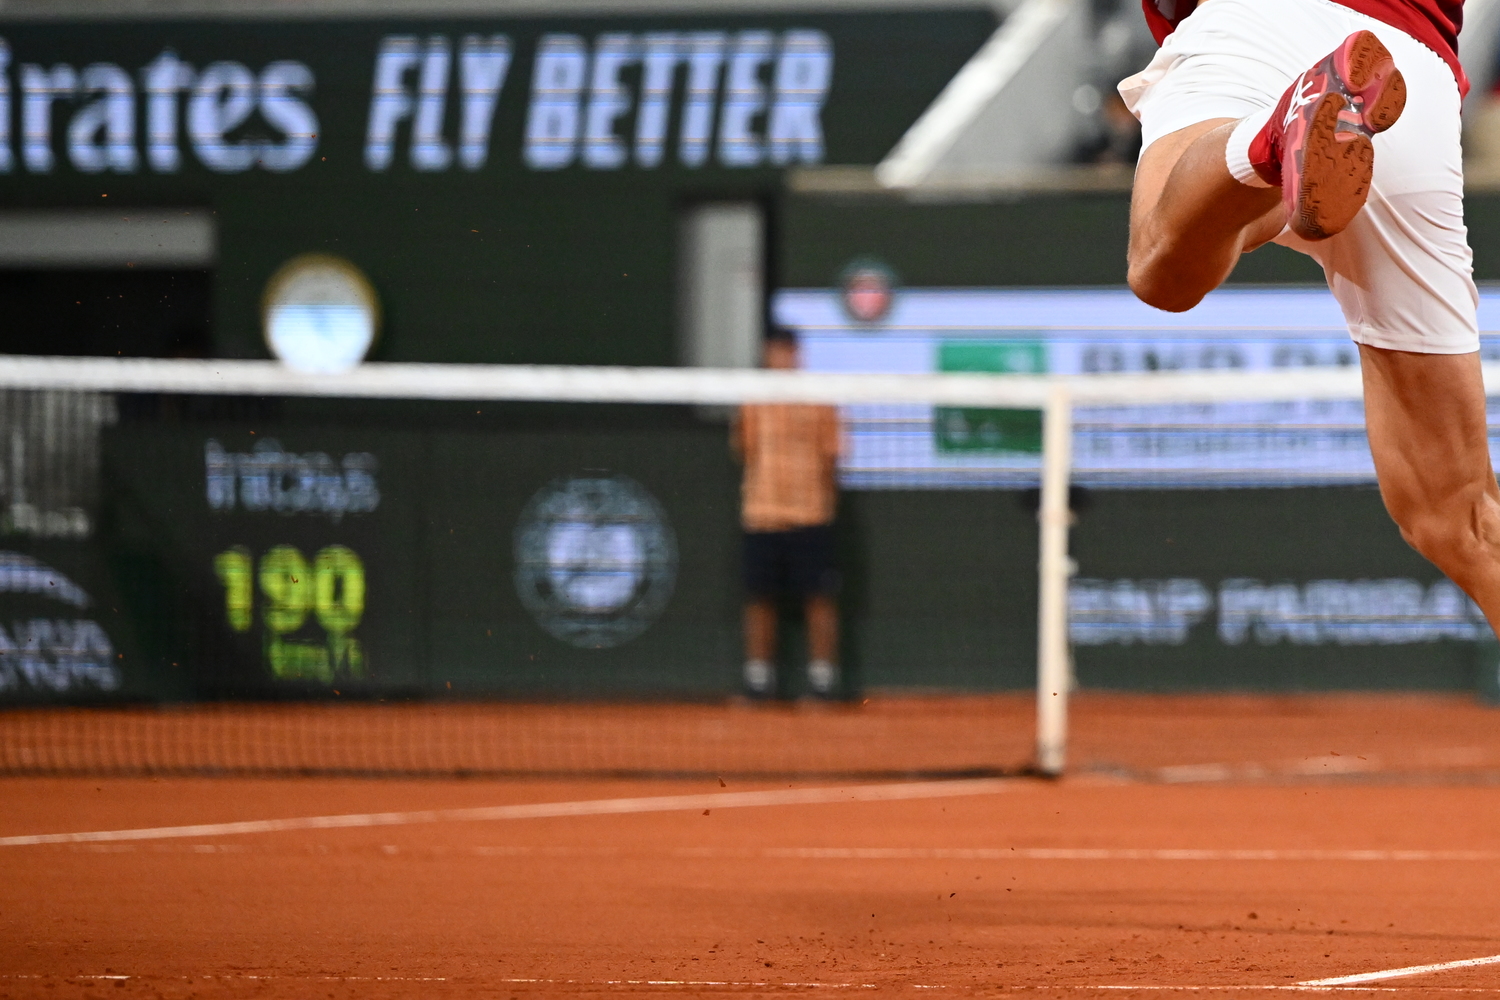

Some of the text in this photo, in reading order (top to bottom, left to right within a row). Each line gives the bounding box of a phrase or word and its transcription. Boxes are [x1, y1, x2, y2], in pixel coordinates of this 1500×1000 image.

[364, 33, 514, 171] FLY
[523, 28, 835, 171] BETTER
[214, 546, 366, 633] 190
[1218, 578, 1490, 645] PARIBA
